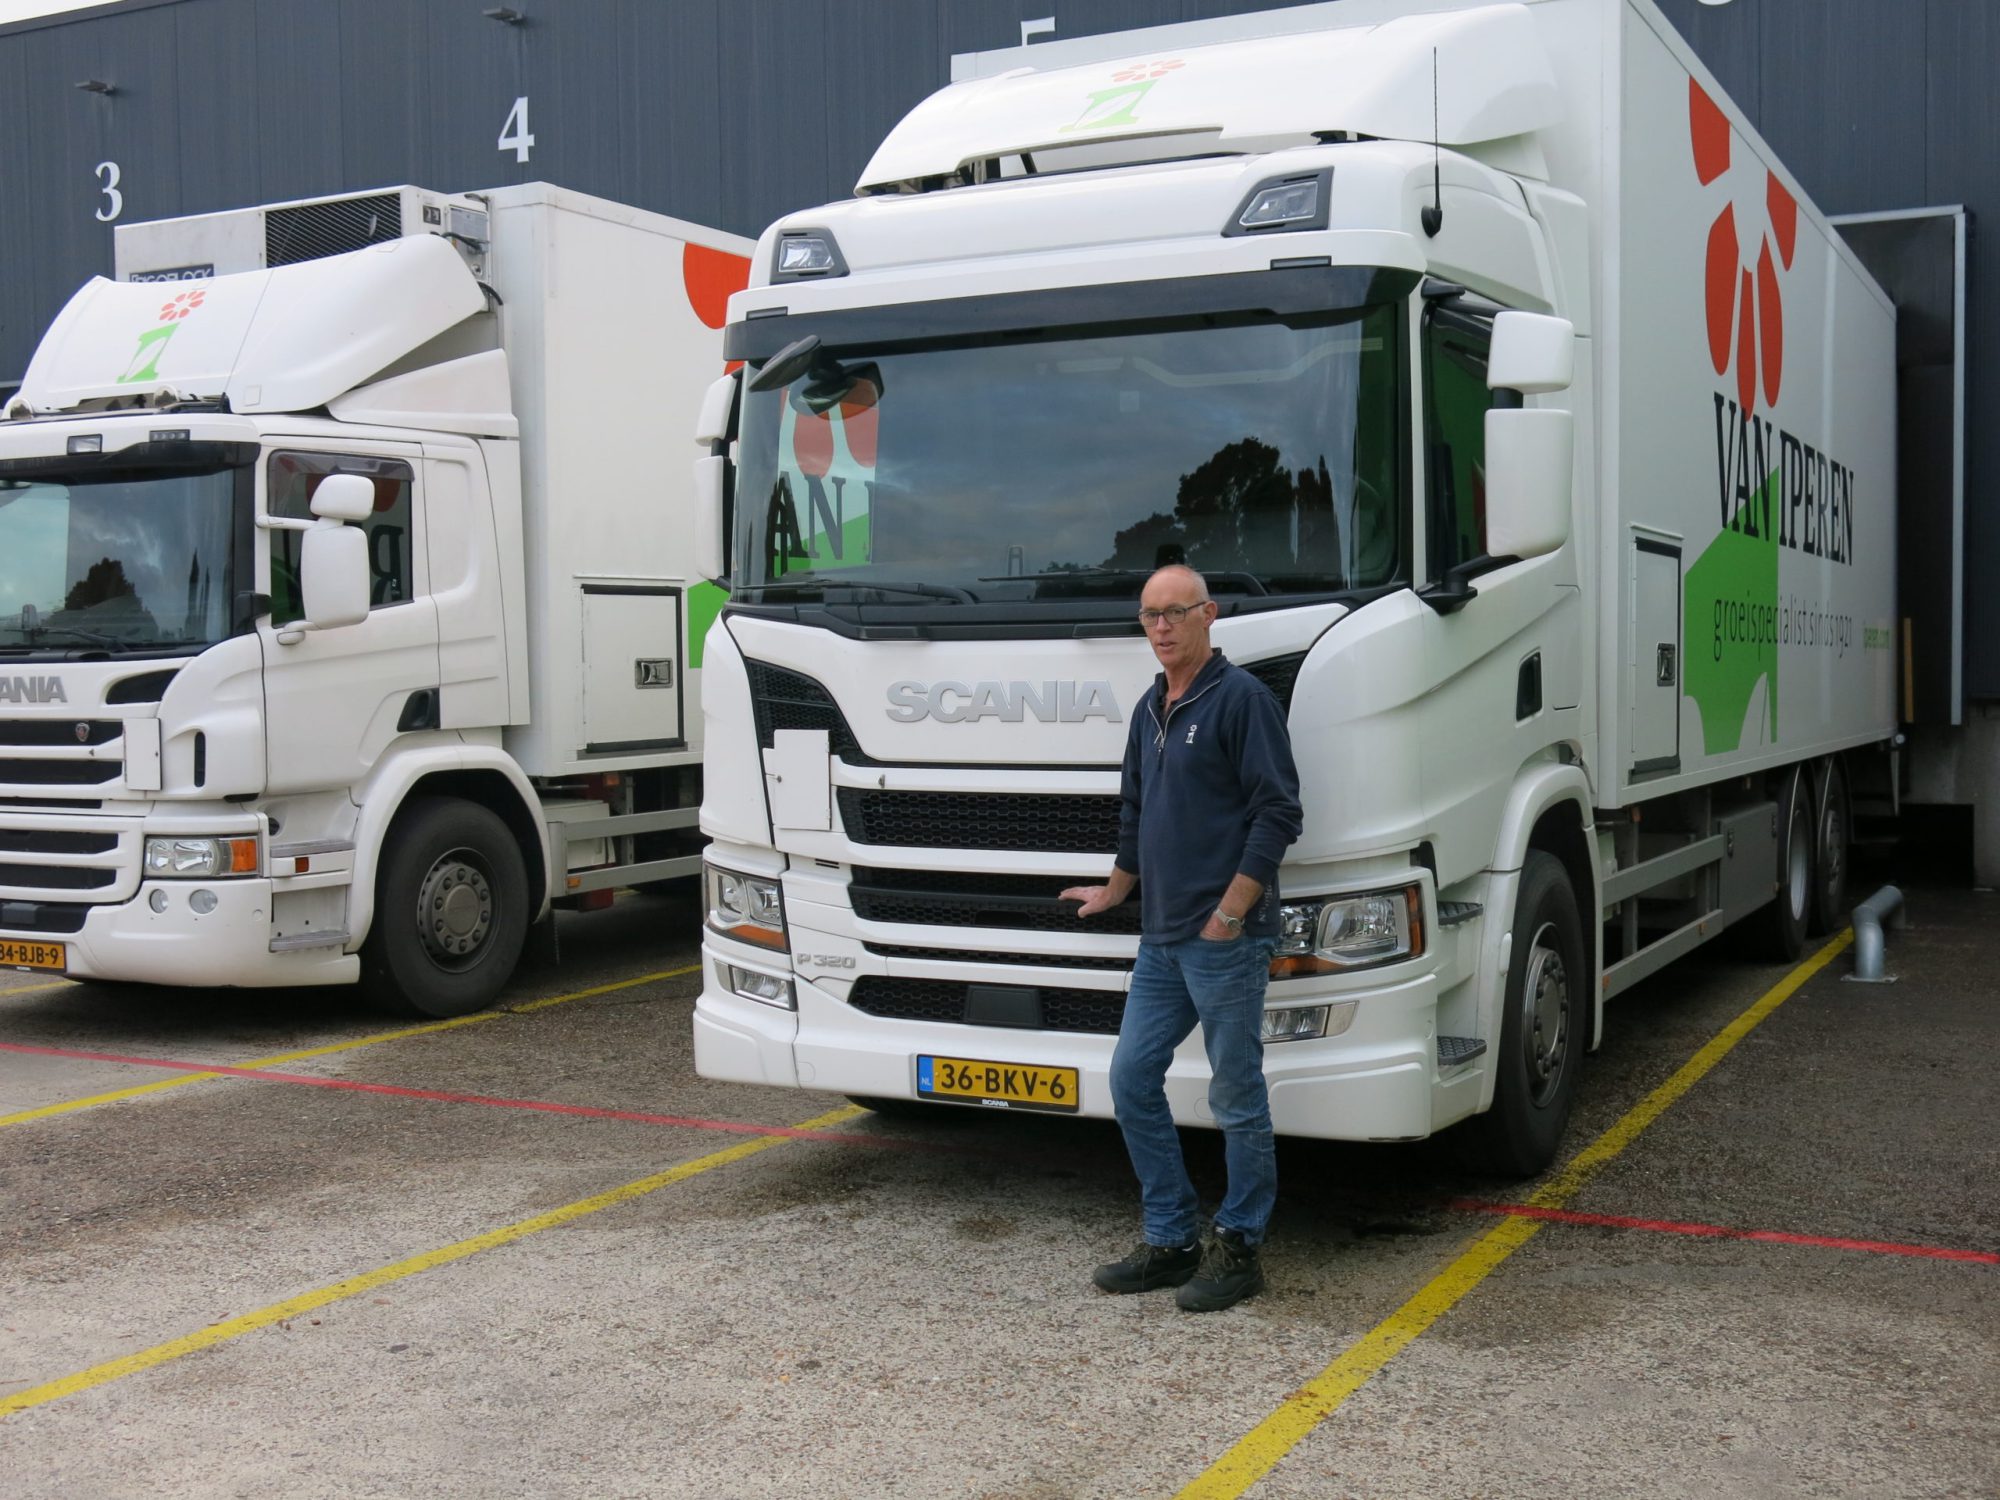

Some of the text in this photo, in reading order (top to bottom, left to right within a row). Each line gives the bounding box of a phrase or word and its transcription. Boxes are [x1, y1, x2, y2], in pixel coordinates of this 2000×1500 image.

[497, 96, 535, 163] 4
[95, 161, 123, 222] 3
[1714, 391, 1854, 566] VAN IPEREN
[1713, 590, 1807, 662] groeispecialist
[885, 680, 1123, 723] SCANIA
[797, 953, 856, 969] P 320
[940, 1063, 1066, 1100] 36-BKV-6
